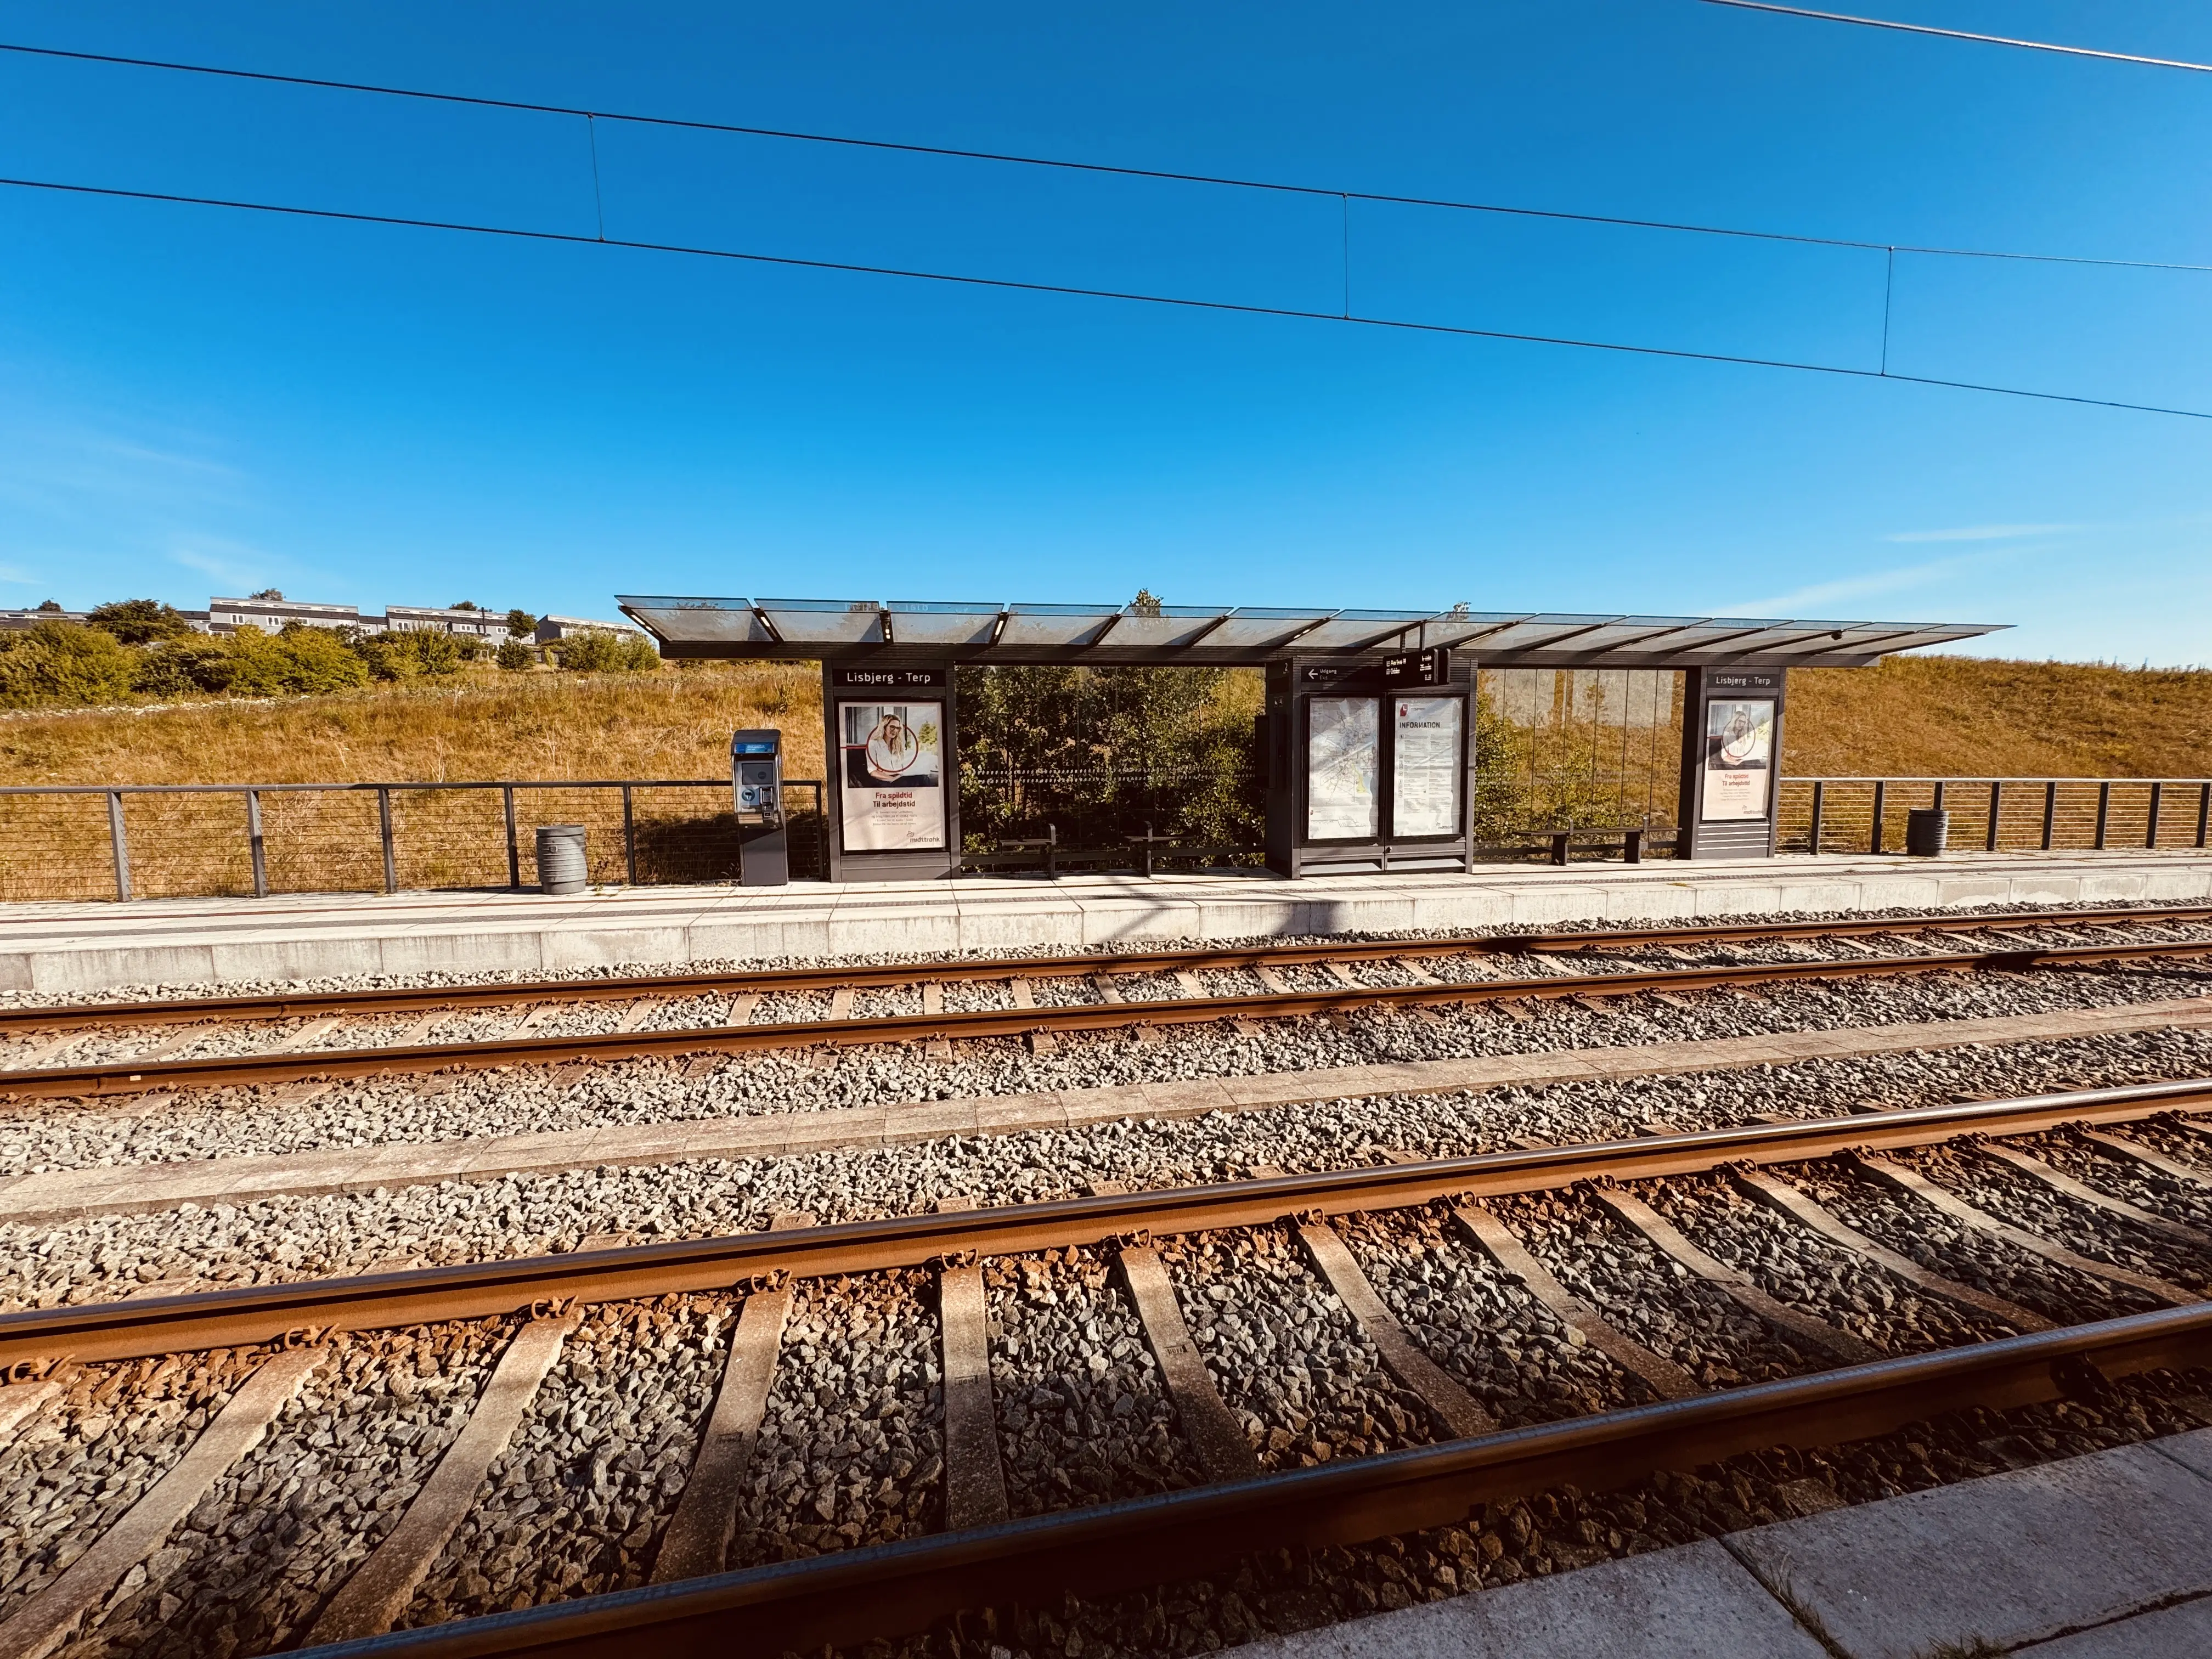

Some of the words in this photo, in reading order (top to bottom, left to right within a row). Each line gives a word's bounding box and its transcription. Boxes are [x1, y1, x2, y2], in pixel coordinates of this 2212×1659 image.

[847, 672, 894, 684] Lisbjerg
[905, 673, 931, 684] Terp
[1716, 676, 1747, 686] Lisbjerg
[1754, 676, 1770, 686] Terp
[888, 792, 912, 801] spildtid
[882, 800, 916, 809] arbejdstid
